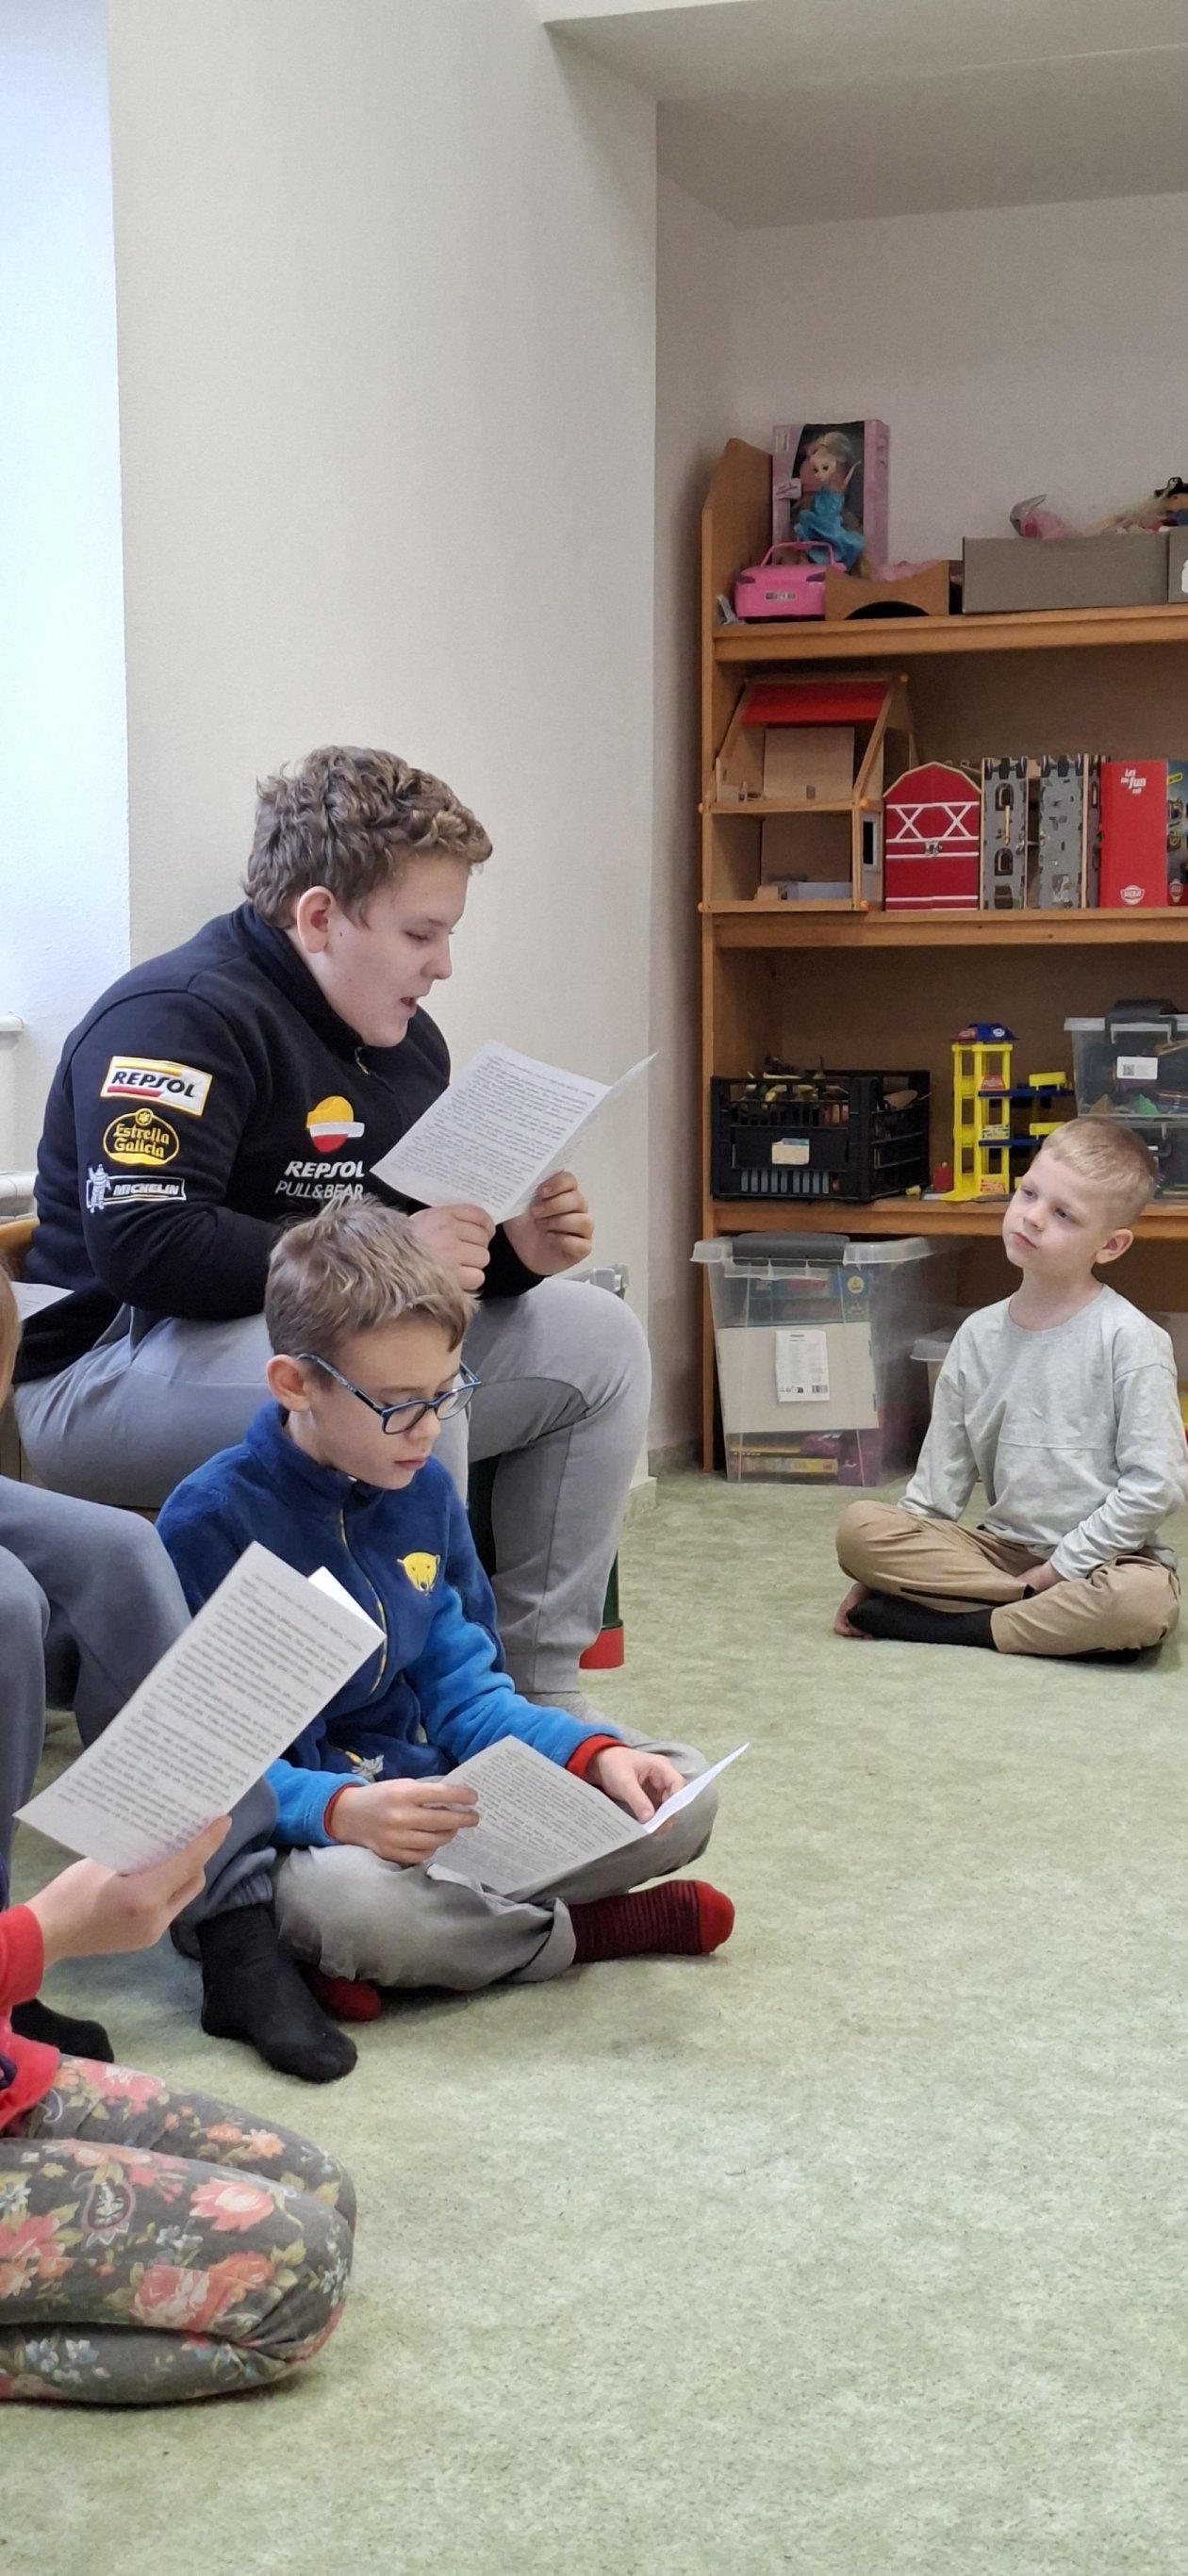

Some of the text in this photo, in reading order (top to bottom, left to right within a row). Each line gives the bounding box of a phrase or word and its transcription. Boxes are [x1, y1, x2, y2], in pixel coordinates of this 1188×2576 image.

[111, 1071, 195, 1098] REPSOL
[113, 1124, 170, 1145] Estrella
[114, 1137, 165, 1158] Galicia
[284, 1160, 365, 1179] REPSOL
[113, 1183, 180, 1196] MICHELIN
[274, 1180, 364, 1200] PULL&BEAR
